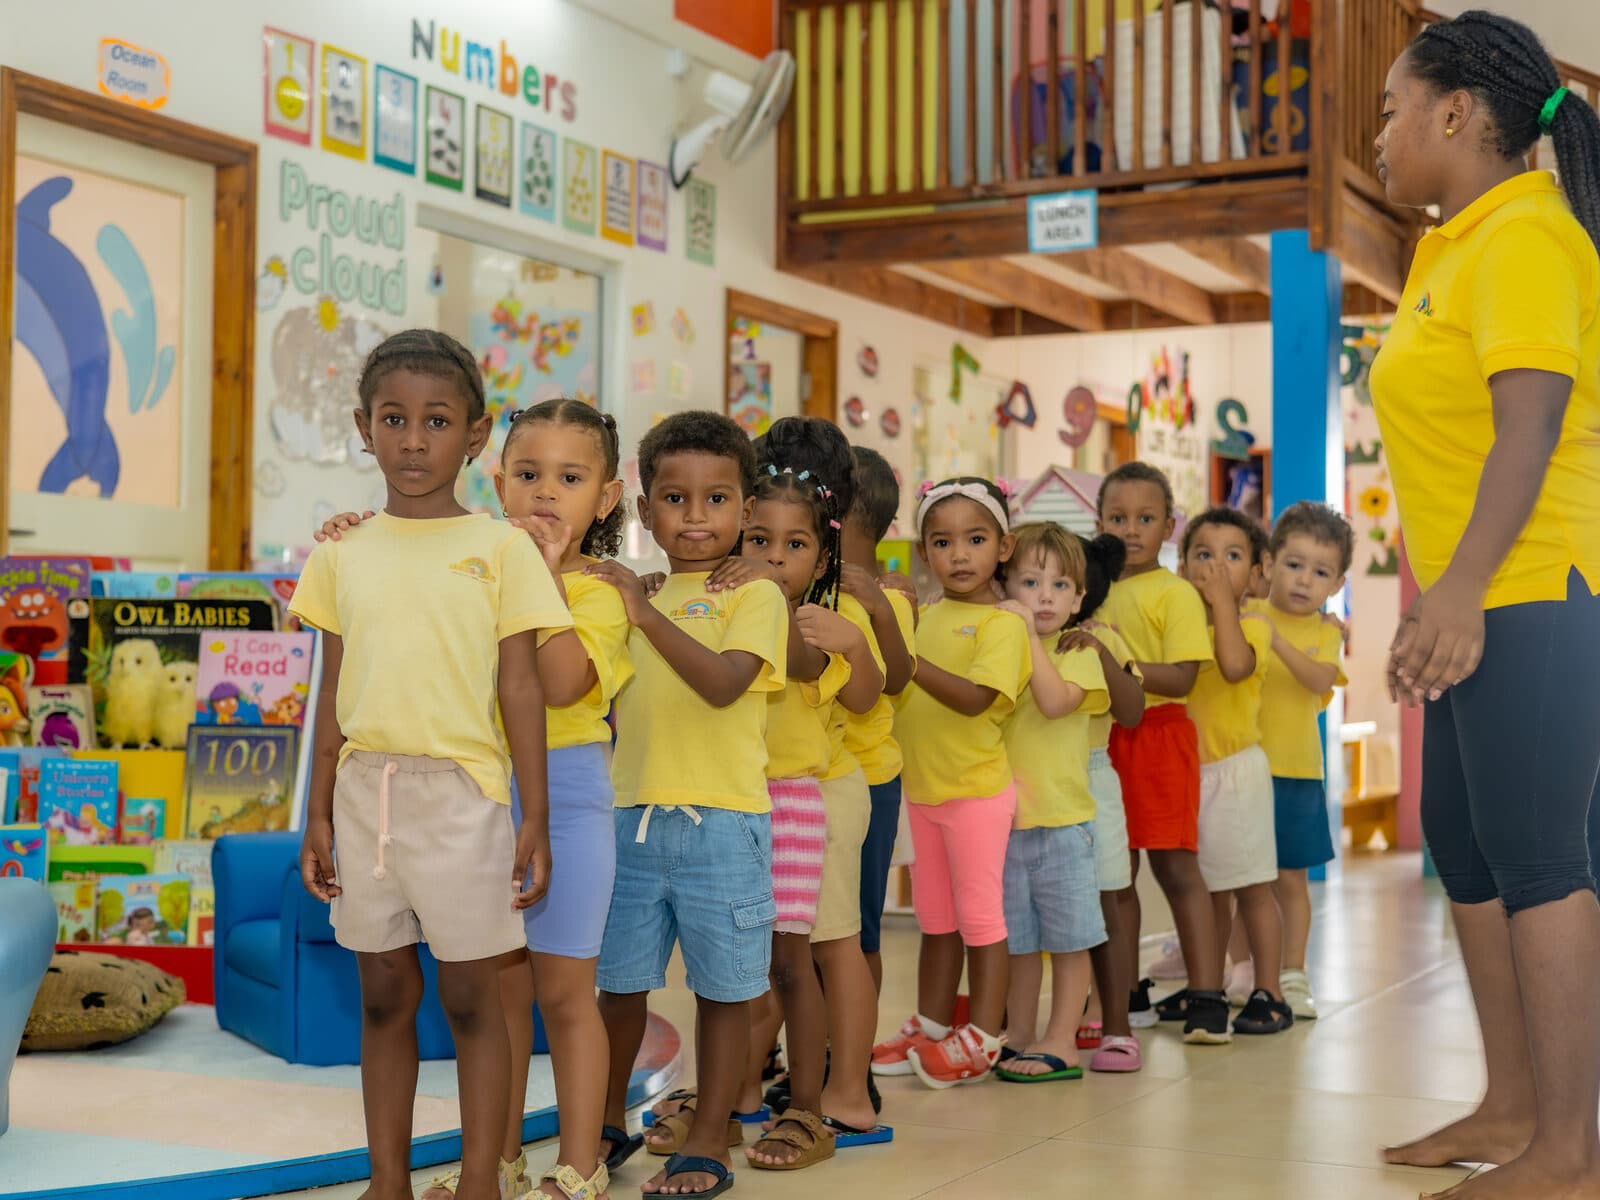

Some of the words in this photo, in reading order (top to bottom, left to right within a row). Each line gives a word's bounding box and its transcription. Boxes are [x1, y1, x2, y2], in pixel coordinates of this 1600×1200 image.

[111, 44, 156, 68] Ocean
[106, 70, 147, 94] Room
[338, 60, 351, 89] 2
[411, 18, 577, 122] Numbers
[574, 147, 586, 173] 7
[280, 159, 405, 251] Proud
[1037, 204, 1087, 223] LUNCH
[1044, 225, 1082, 241] AREA
[291, 233, 408, 316] cloud
[1058, 385, 1096, 449] 9
[232, 638, 239, 652] I
[247, 638, 282, 654] Can
[224, 655, 288, 678] Read
[204, 738, 277, 777] 100
[53, 771, 109, 784] Unicorn
[57, 785, 105, 797] Stories
